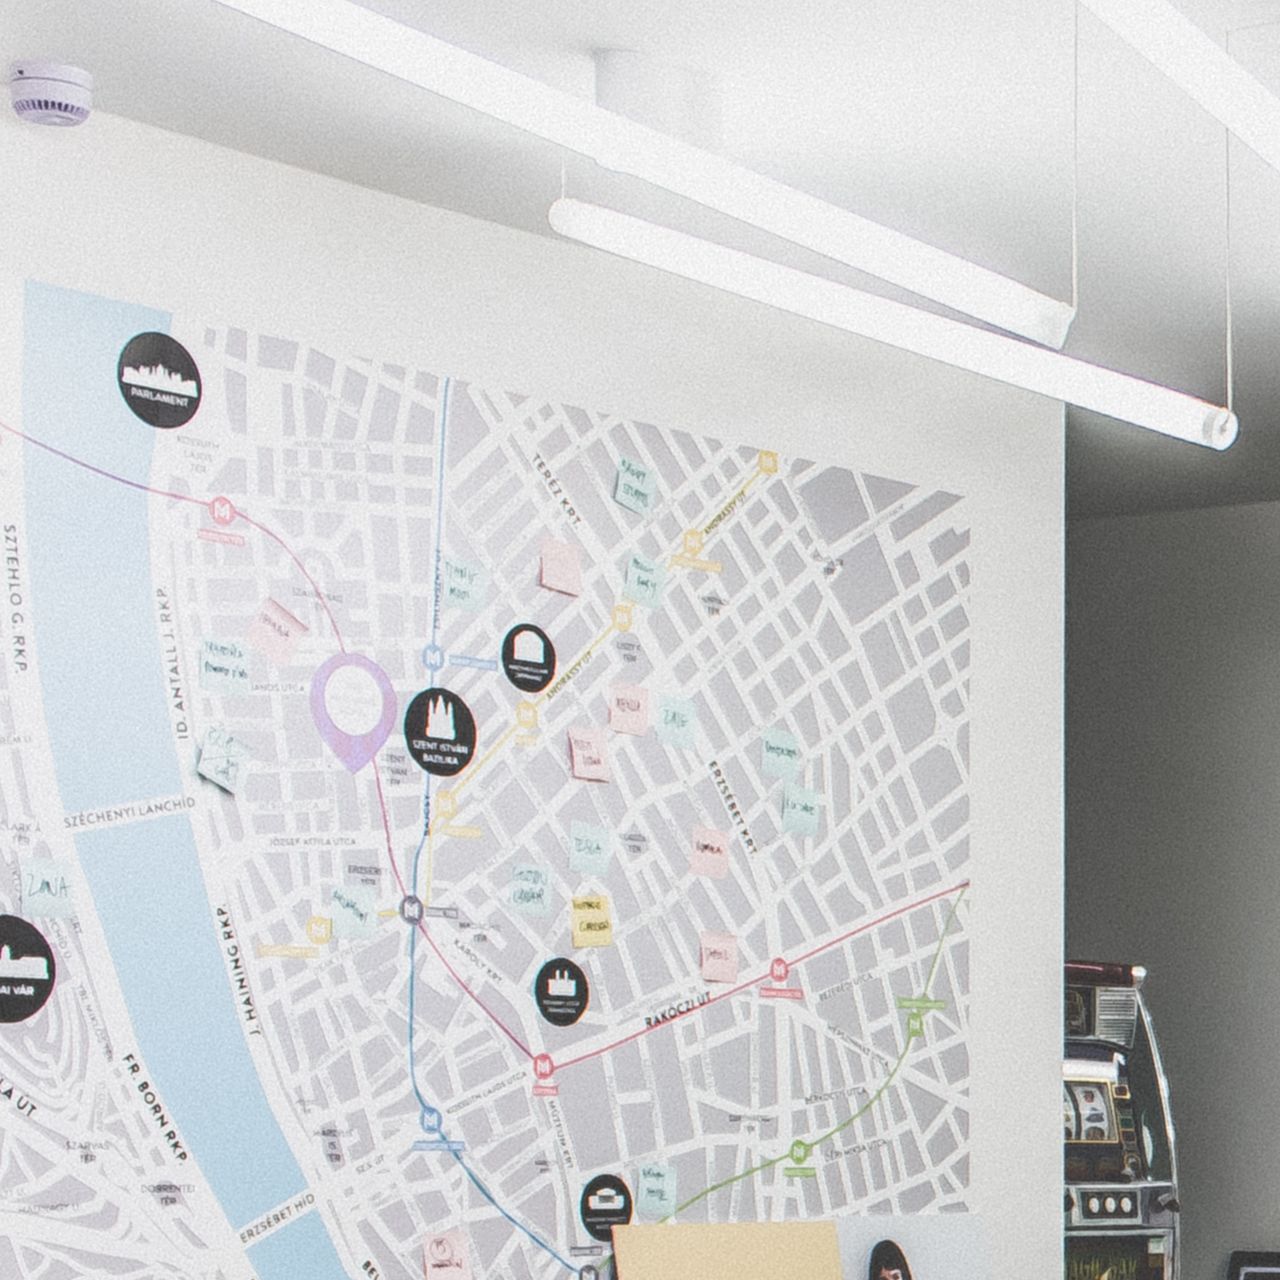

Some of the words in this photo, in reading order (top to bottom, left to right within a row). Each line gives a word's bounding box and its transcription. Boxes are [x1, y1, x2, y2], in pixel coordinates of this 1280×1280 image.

[131, 387, 189, 408] PARLAMENT
[3, 524, 23, 607] SZTEHLO
[156, 586, 172, 624] RKP.
[12, 634, 29, 676] RKP.
[167, 647, 189, 712] ANTALL
[412, 738, 439, 751] SZENT
[422, 753, 459, 766] BAZILIKA
[708, 759, 744, 827] ERZSÉBET
[63, 806, 136, 829] SZÉCHENYI
[216, 903, 237, 942] RKP.
[14, 984, 35, 996] VÁR
[226, 944, 259, 1022] HAINING
[122, 1052, 141, 1082] FR.
[137, 1080, 170, 1128] BORN
[163, 1129, 189, 1168] RKP.
[240, 1206, 293, 1244] ERZSÉBET
[294, 1192, 316, 1213] HÍD
